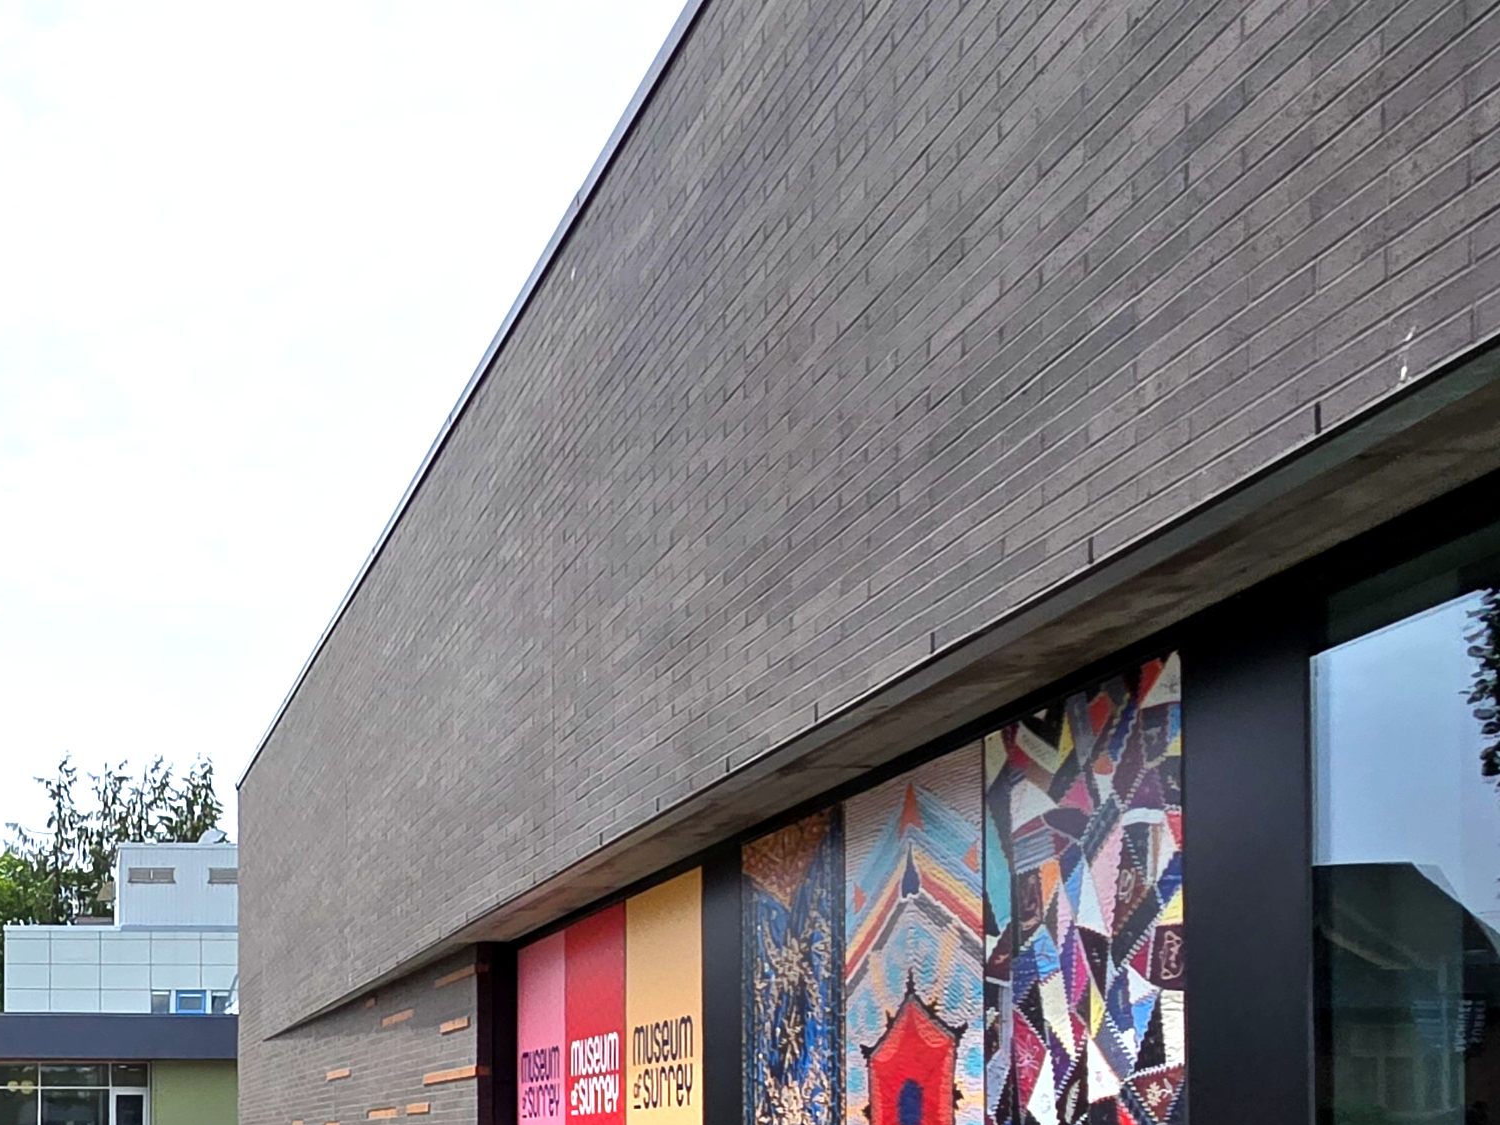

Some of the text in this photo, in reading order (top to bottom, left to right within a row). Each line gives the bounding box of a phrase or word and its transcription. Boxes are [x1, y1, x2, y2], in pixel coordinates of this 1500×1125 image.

[570, 1031, 619, 1077] museum
[633, 1015, 693, 1066] museum
[521, 1045, 560, 1083] museum
[528, 1083, 560, 1118] surrey
[579, 1074, 619, 1115] surrey
[634, 1063, 693, 1109] of surrey
